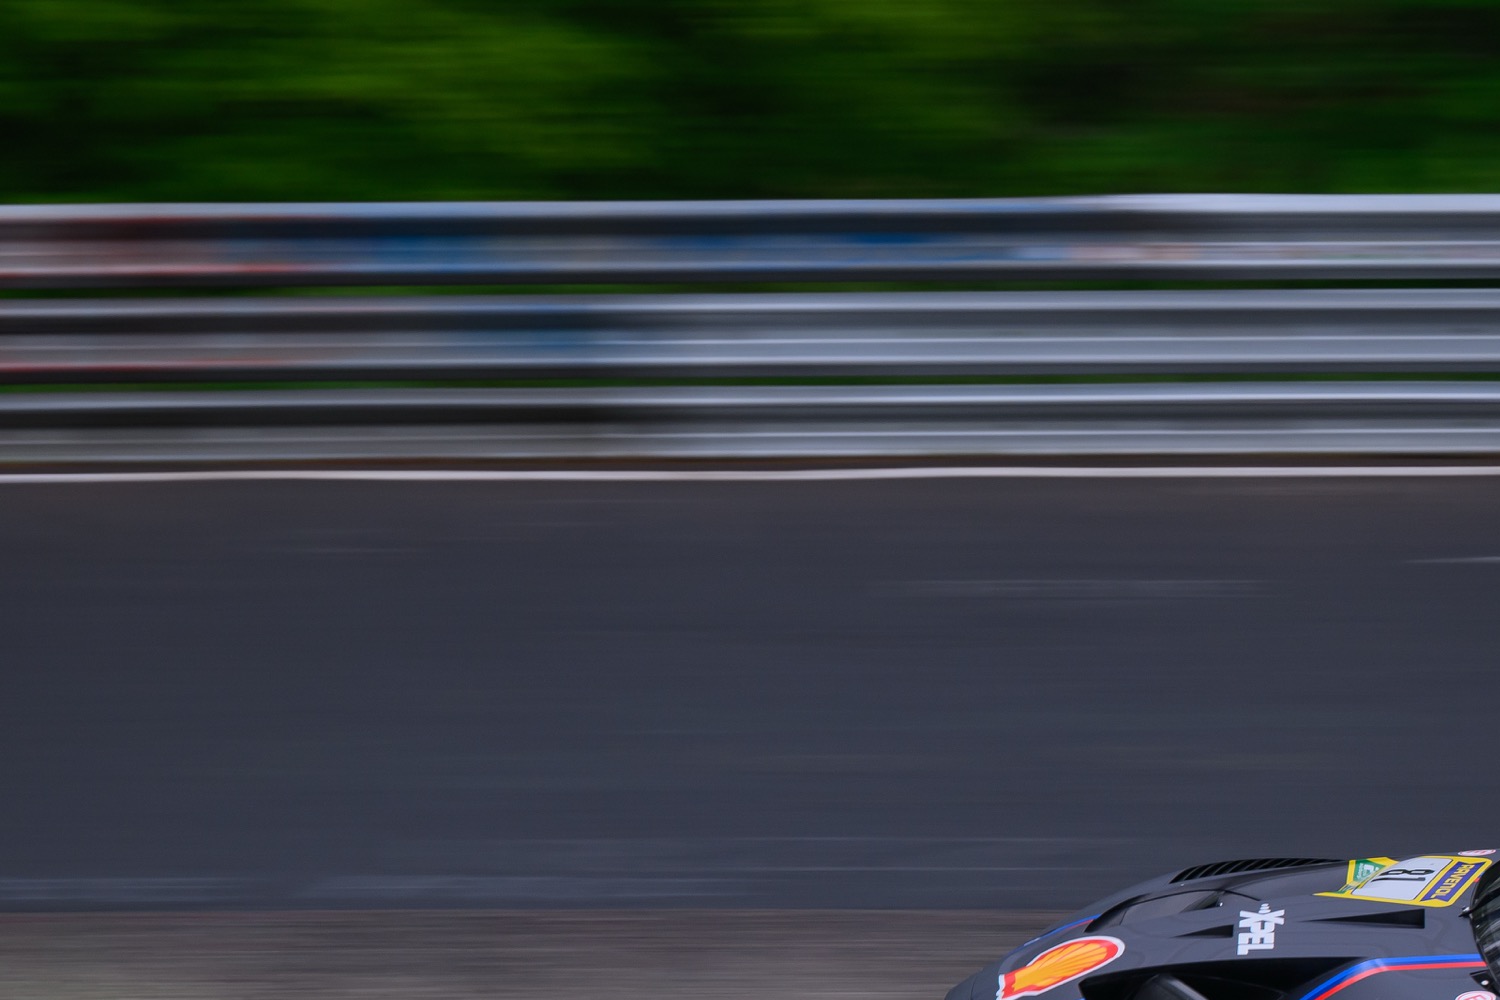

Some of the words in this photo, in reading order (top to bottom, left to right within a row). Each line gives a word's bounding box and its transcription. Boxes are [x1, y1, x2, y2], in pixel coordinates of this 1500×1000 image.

[1370, 868, 1435, 883] 81
[1430, 864, 1475, 899] RAVENOL
[1237, 909, 1285, 955] XPEL
